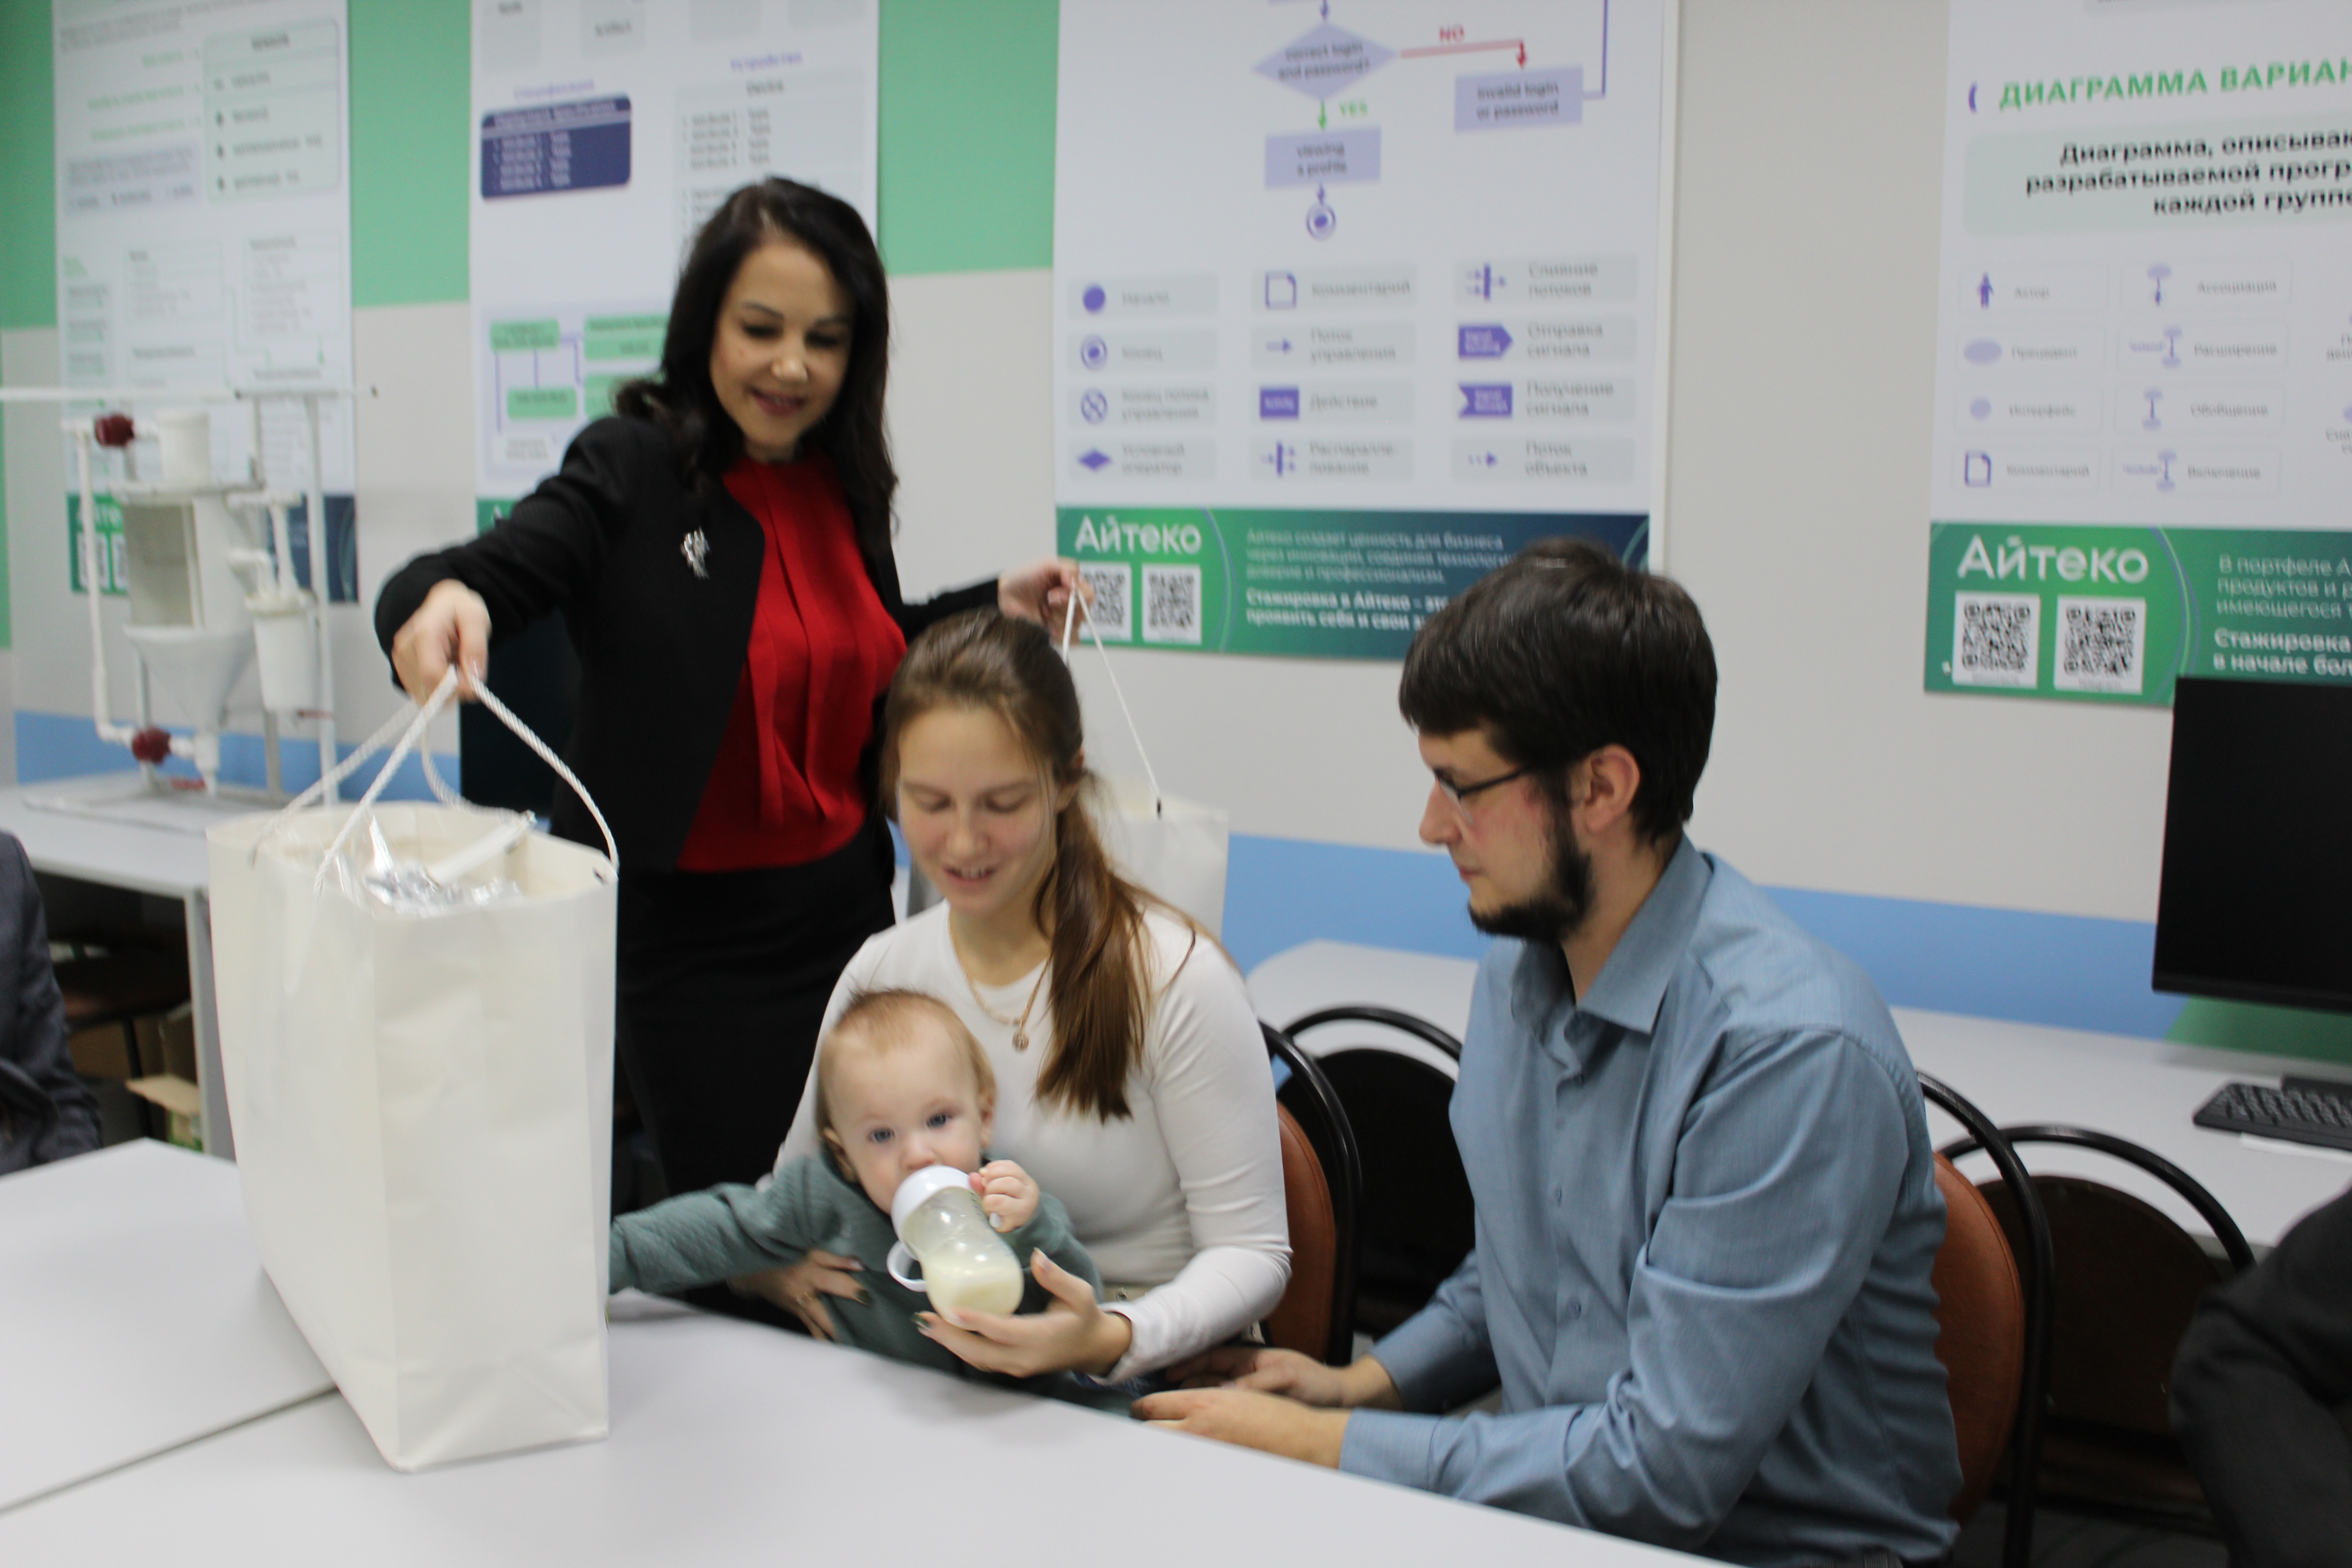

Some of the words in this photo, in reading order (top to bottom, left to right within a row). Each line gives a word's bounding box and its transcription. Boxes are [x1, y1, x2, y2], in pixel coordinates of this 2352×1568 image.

[1439, 24, 1464, 44] NO
[1999, 68, 2208, 113] ДИАГРАММА
[2060, 137, 2213, 167] Диаграмма,
[2027, 160, 2259, 198] разрабатываемой
[2154, 187, 2254, 216] каждой
[1073, 514, 1203, 554] Айтеко
[1956, 533, 2150, 584] Айтеко
[2214, 627, 2352, 655] Стажировка
[2214, 652, 2227, 671] в
[2230, 654, 2308, 676] начале
